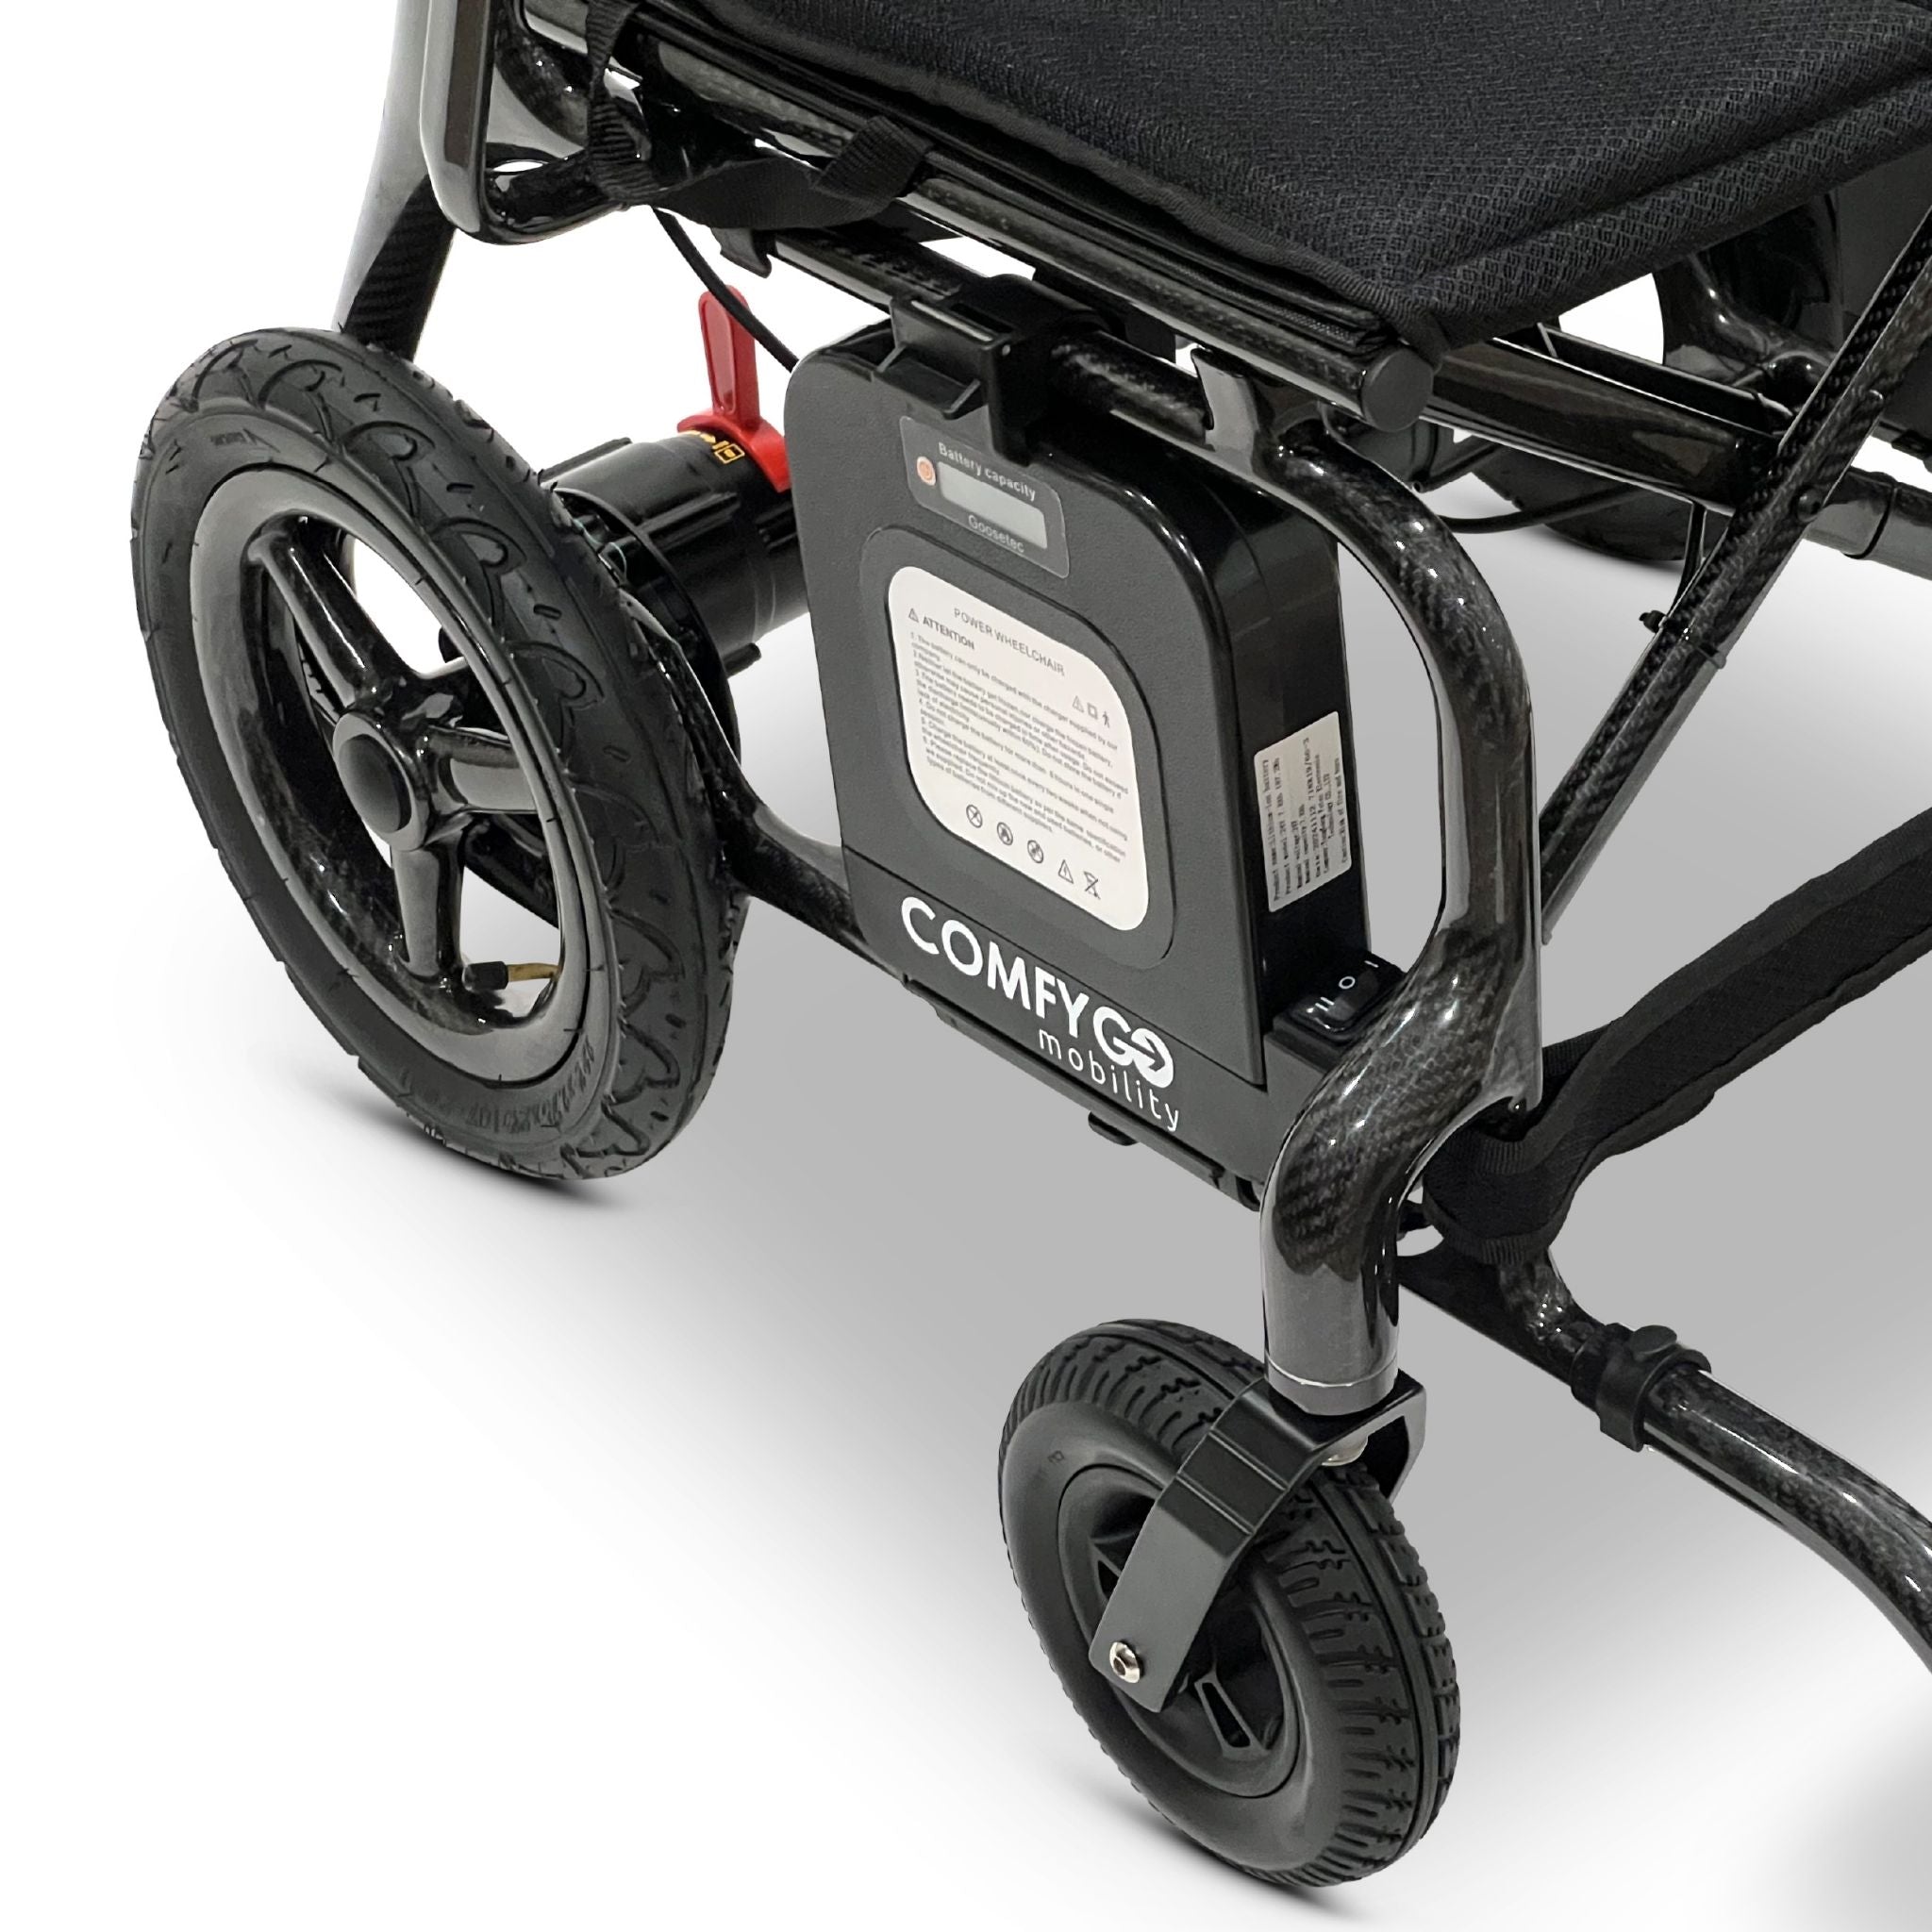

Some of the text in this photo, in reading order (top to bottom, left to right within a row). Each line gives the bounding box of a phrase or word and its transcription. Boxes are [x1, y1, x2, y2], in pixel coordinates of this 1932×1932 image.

[939, 441, 1036, 502] Battery capacity
[923, 616, 974, 650] ATTENTION
[954, 608, 1065, 676] POWER WHEELCHAIR
[1038, 1028, 1179, 1132] mobility
